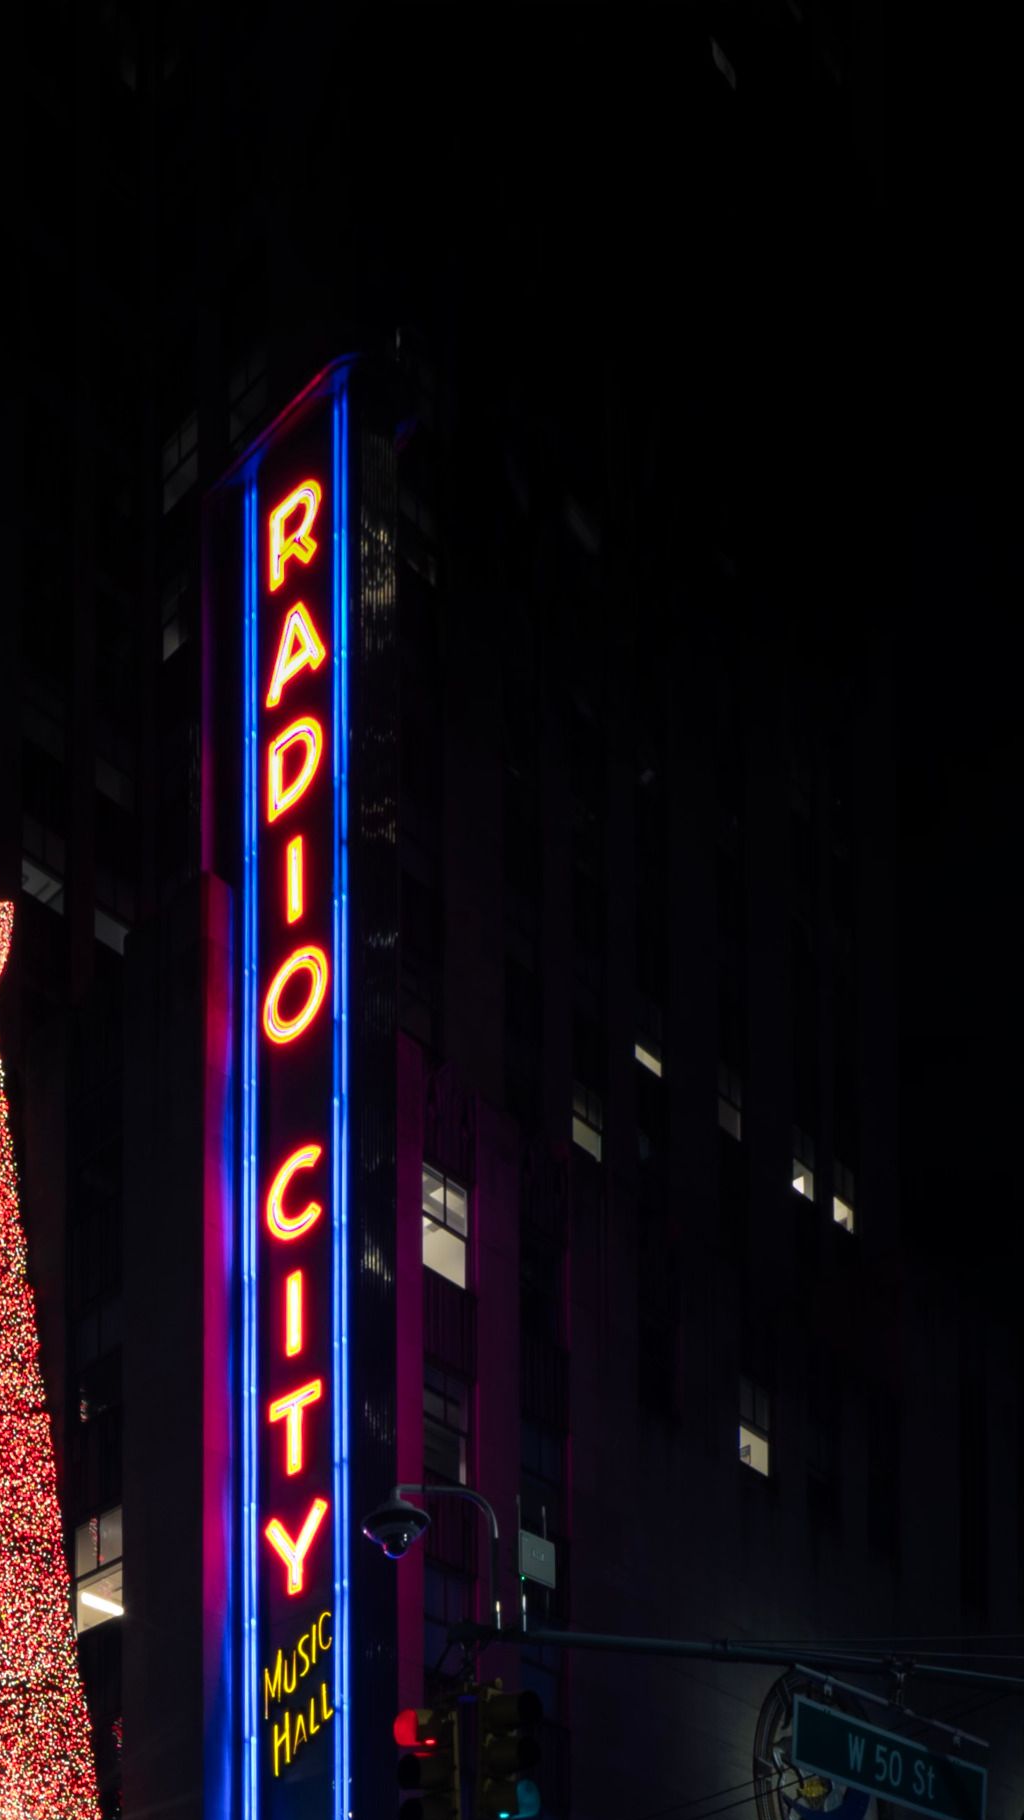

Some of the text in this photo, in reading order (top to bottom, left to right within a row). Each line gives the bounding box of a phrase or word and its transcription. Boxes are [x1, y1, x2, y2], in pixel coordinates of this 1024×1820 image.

[263, 478, 328, 1596] RADIO CITY
[848, 1731, 936, 1800] W 50 St
